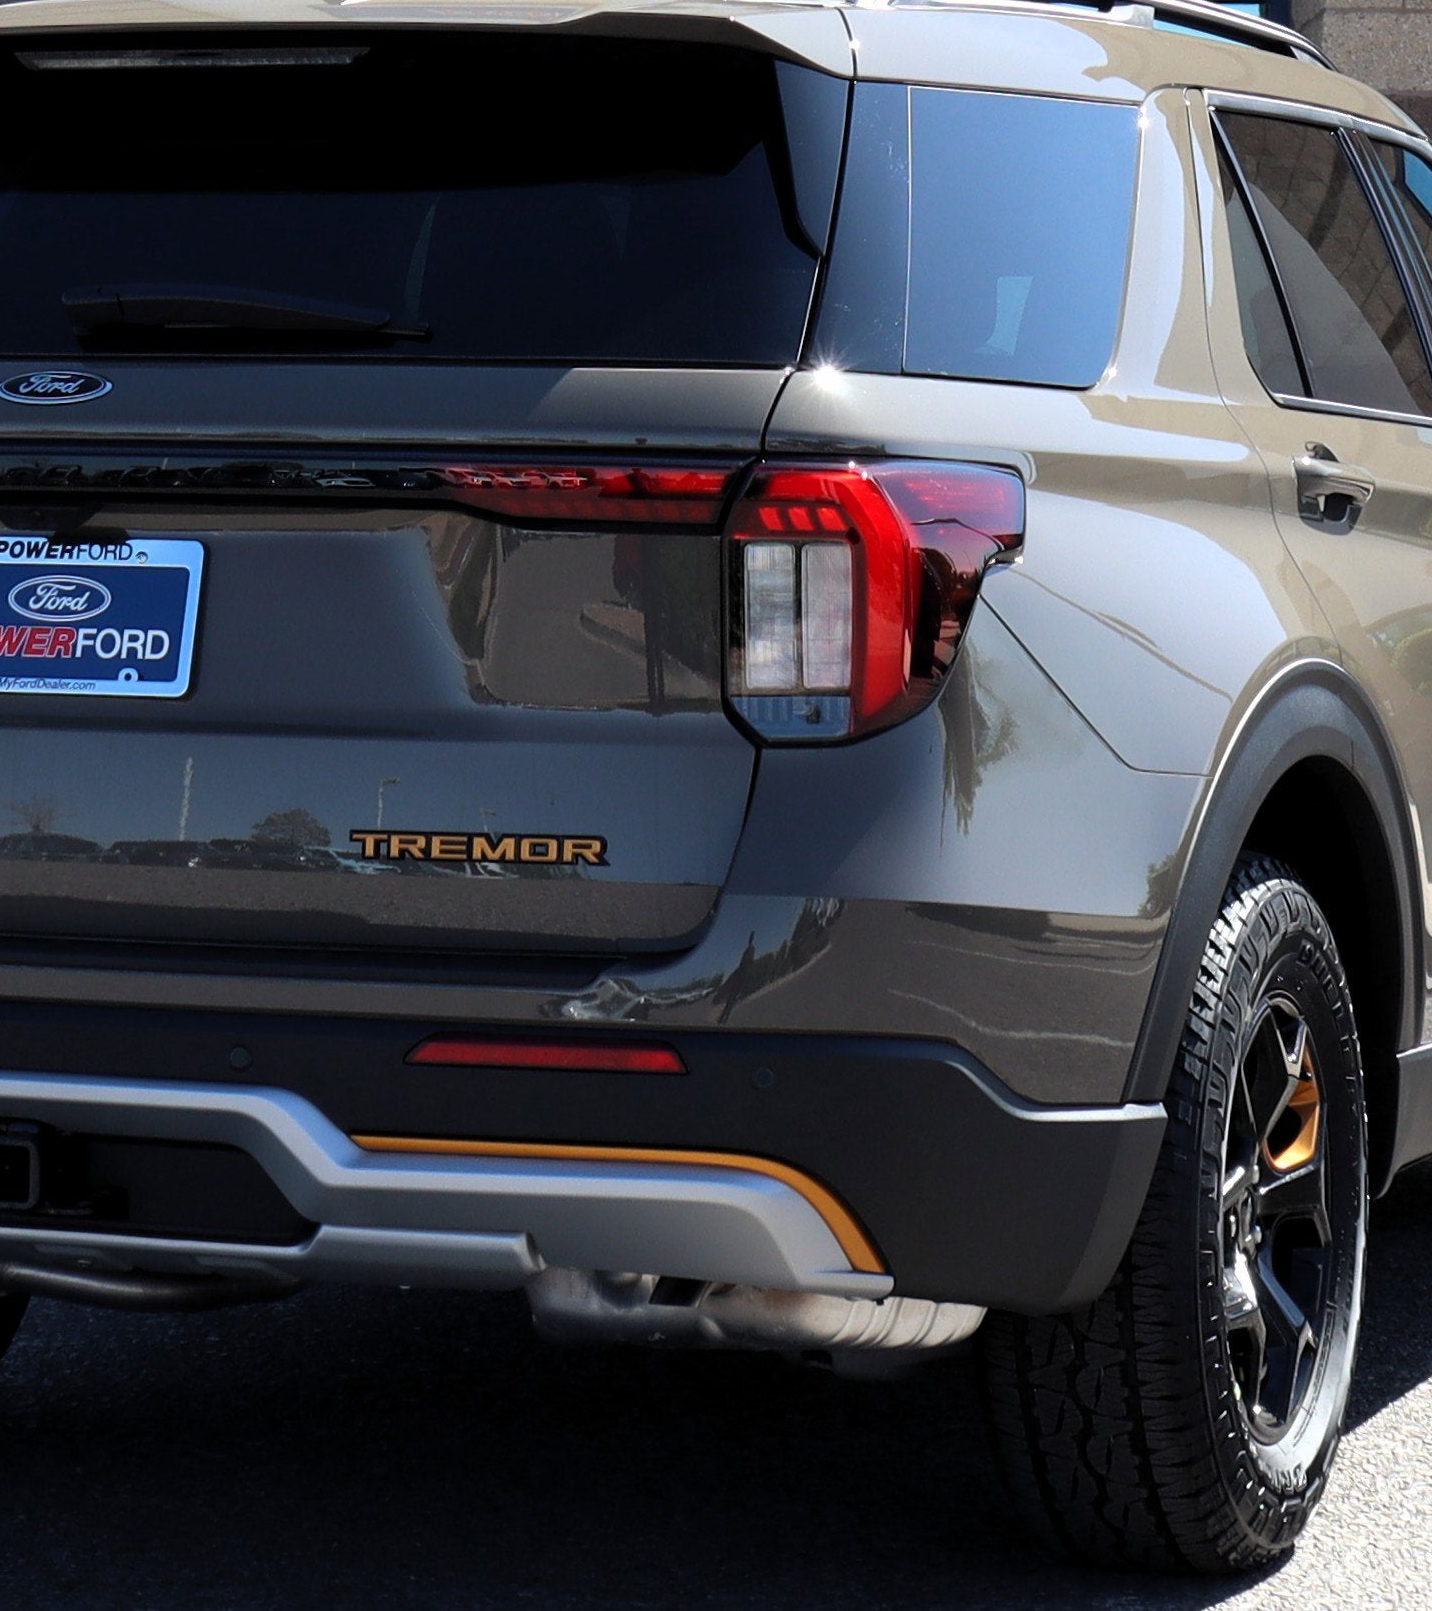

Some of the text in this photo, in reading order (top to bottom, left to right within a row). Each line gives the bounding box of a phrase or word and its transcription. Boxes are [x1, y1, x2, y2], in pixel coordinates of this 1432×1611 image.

[18, 373, 86, 395] Ford
[28, 582, 94, 612] Ford
[350, 831, 608, 866] TREMOR
